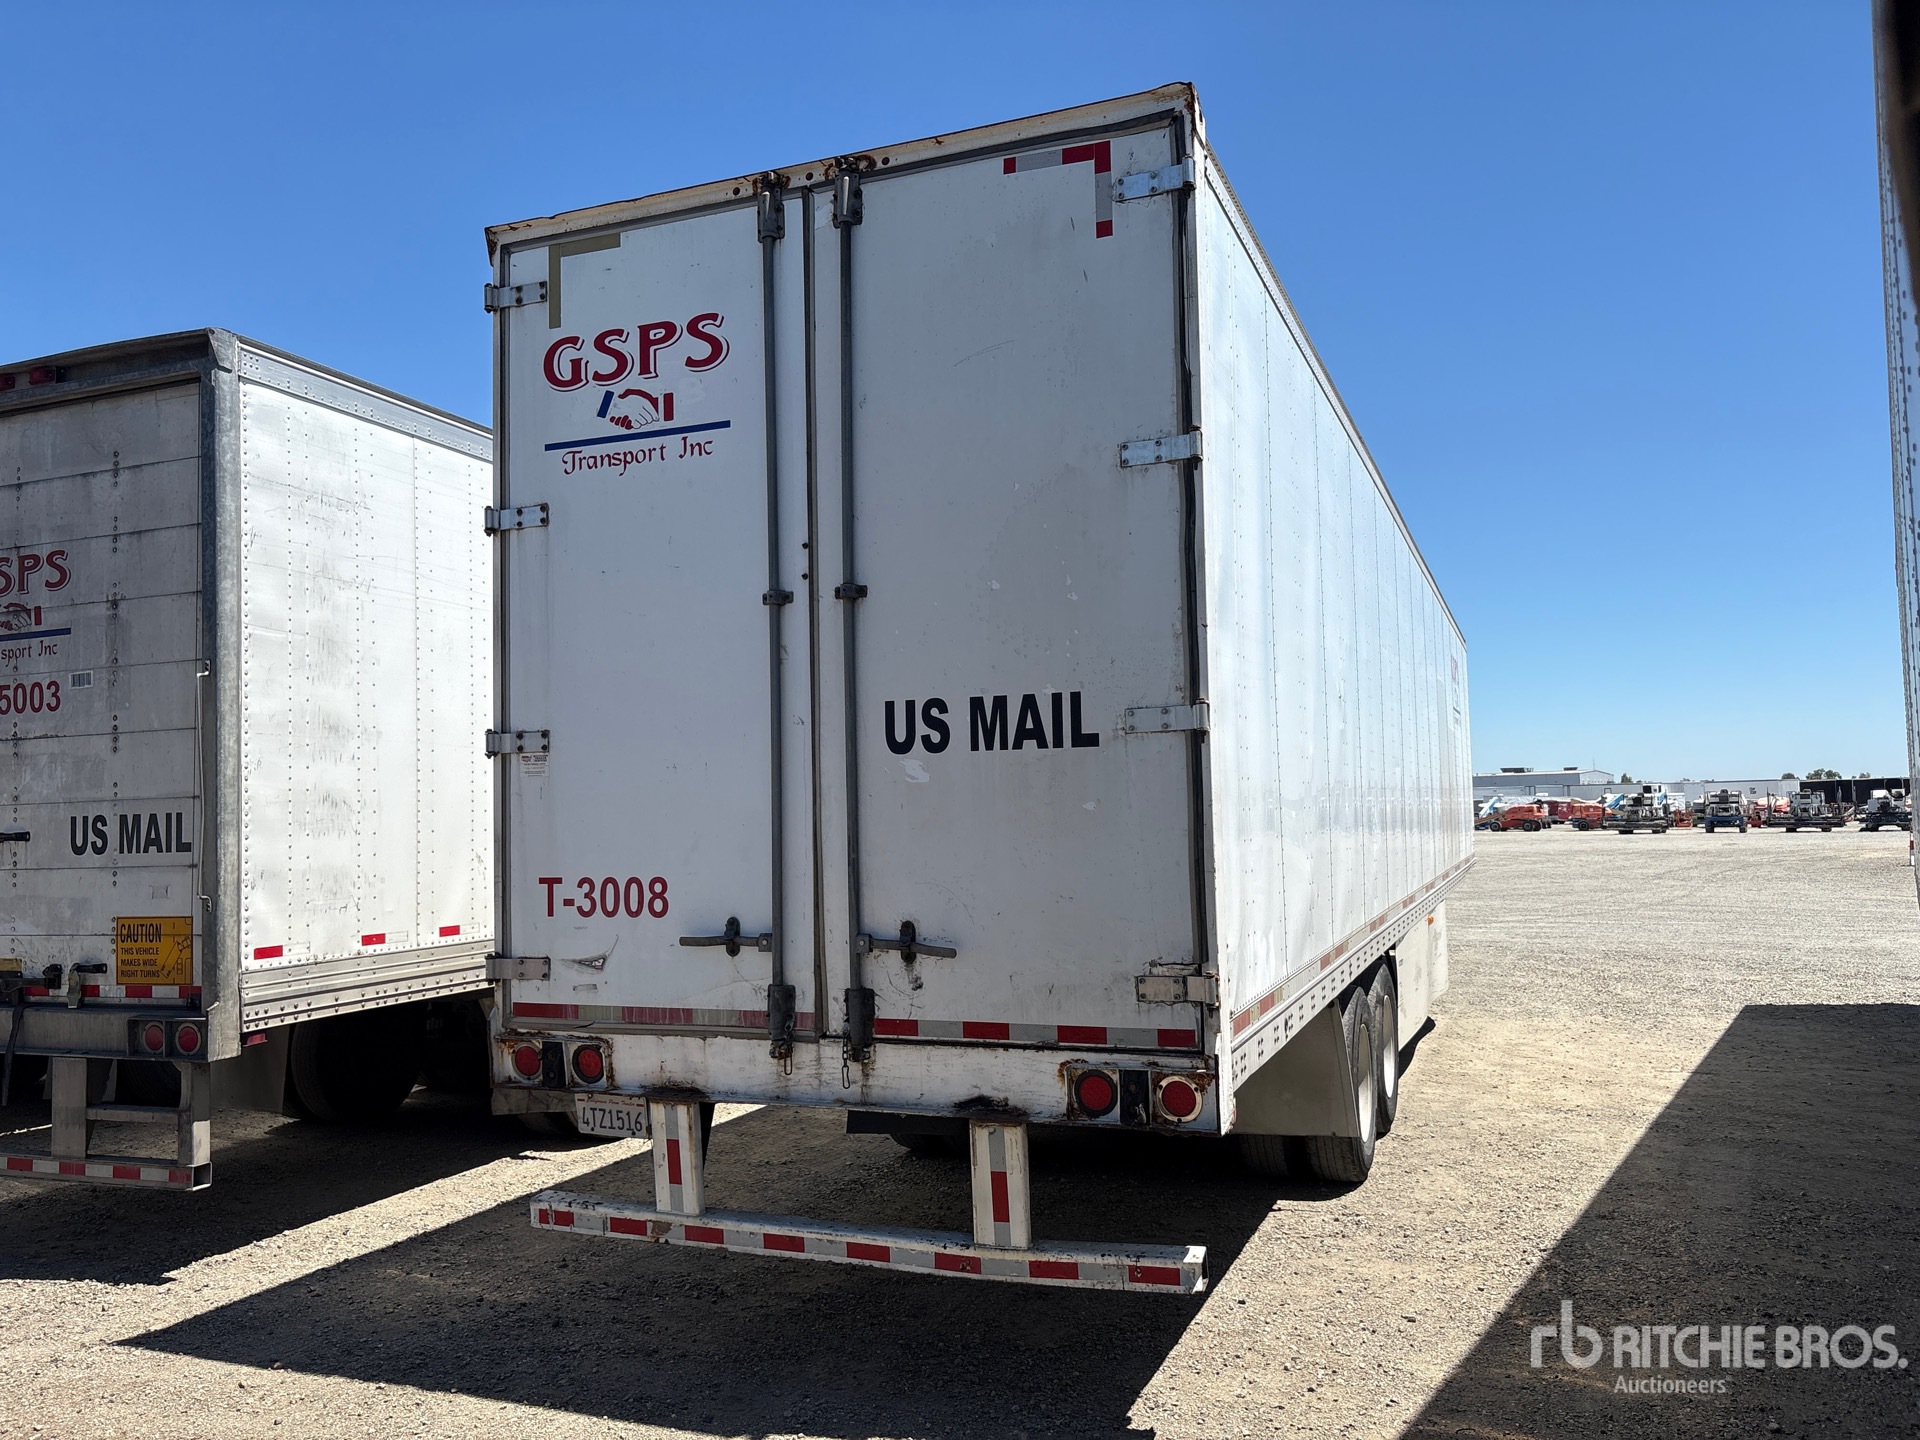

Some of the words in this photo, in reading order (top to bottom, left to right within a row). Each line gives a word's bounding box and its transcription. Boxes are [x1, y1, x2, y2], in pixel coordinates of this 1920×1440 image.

[543, 312, 730, 392] GSPS
[561, 442, 667, 477] Transport
[885, 697, 951, 755] US
[969, 691, 1100, 752] MAIL
[70, 815, 108, 856] US
[118, 812, 192, 854] MAIL
[538, 876, 669, 918] T-3008
[120, 923, 162, 943] CAUTION
[121, 947, 134, 955] THIS
[135, 947, 160, 955] VEHICLE
[121, 958, 141, 967] MAKES
[142, 958, 158, 967] WIDE
[121, 969, 139, 978] RIGHT
[140, 969, 160, 978] TURNS
[582, 1106, 643, 1132] 4TZ1516
